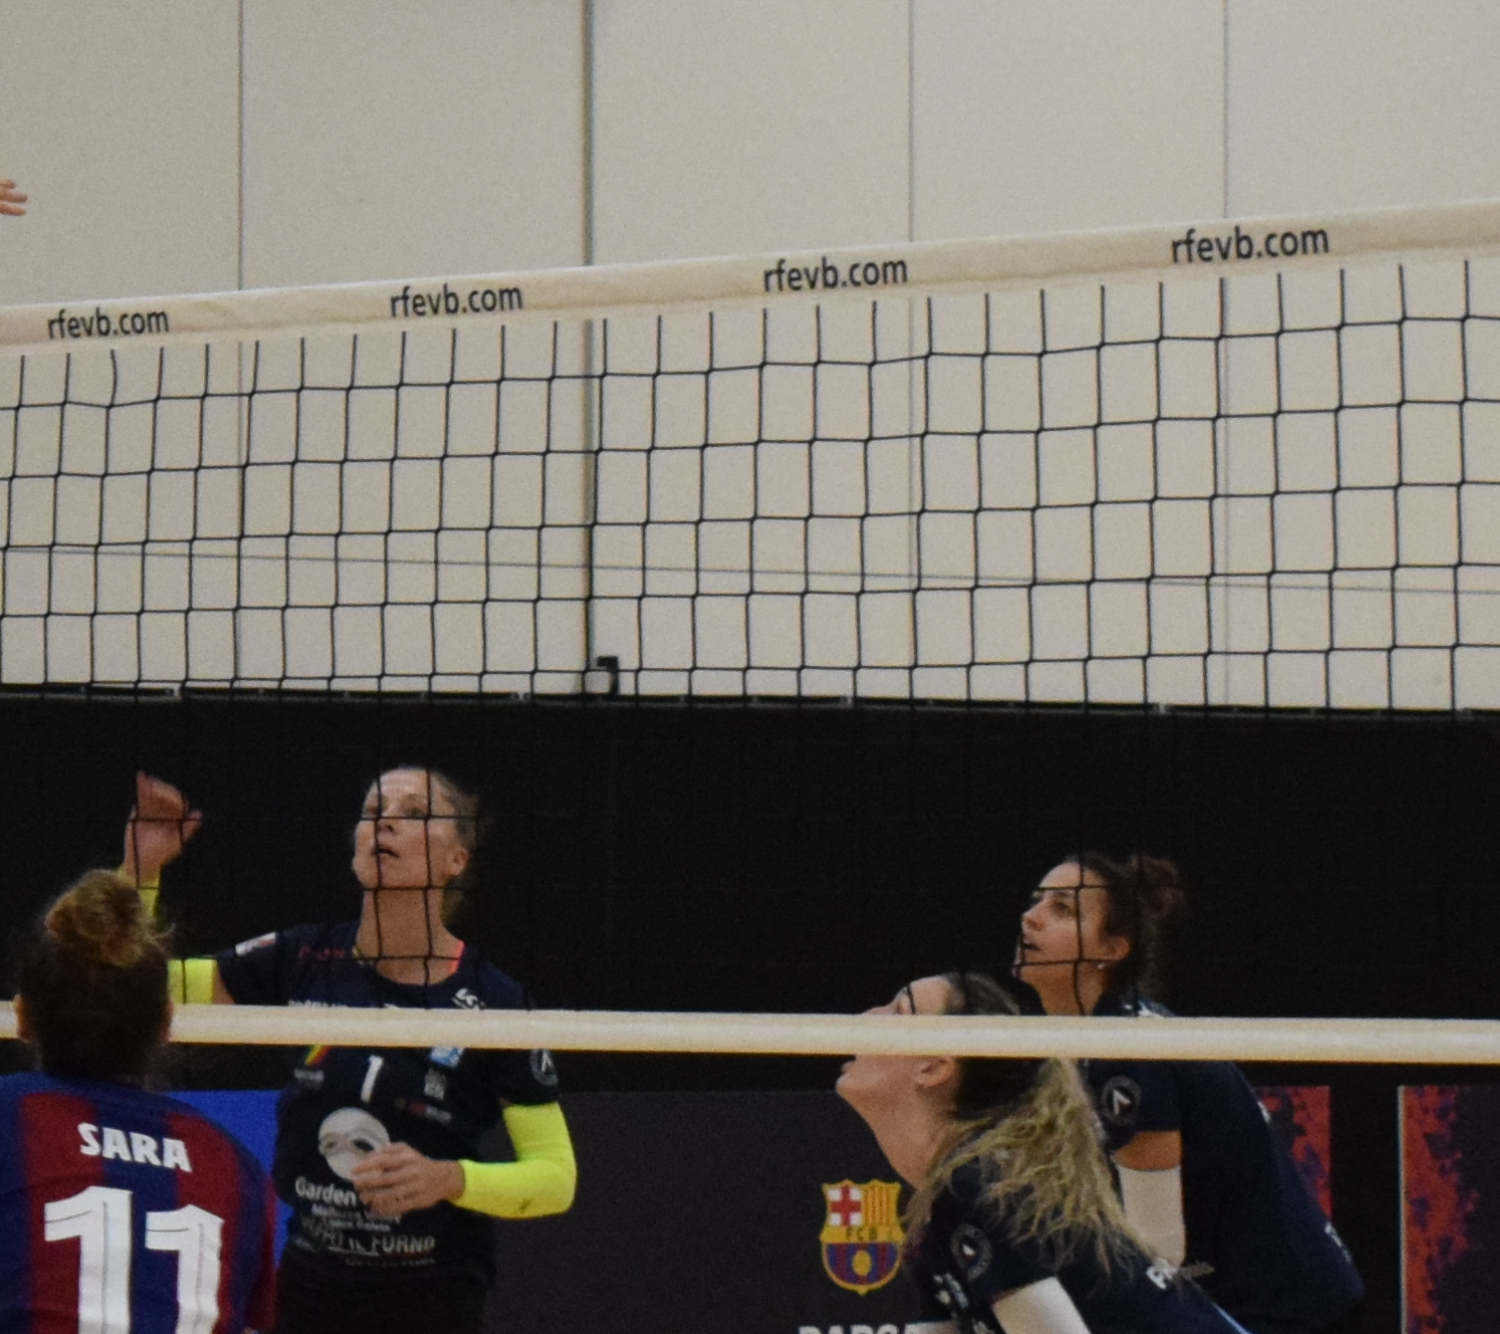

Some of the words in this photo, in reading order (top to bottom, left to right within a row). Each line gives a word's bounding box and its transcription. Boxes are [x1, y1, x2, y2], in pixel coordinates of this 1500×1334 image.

[1171, 226, 1329, 264] rfevb.com
[763, 256, 908, 292] rfevb.com
[389, 283, 523, 318] rfevb.com
[47, 305, 169, 339] rfevb.com
[361, 1054, 384, 1103] 1
[77, 1122, 192, 1172] SARA
[295, 1175, 356, 1208] Garden
